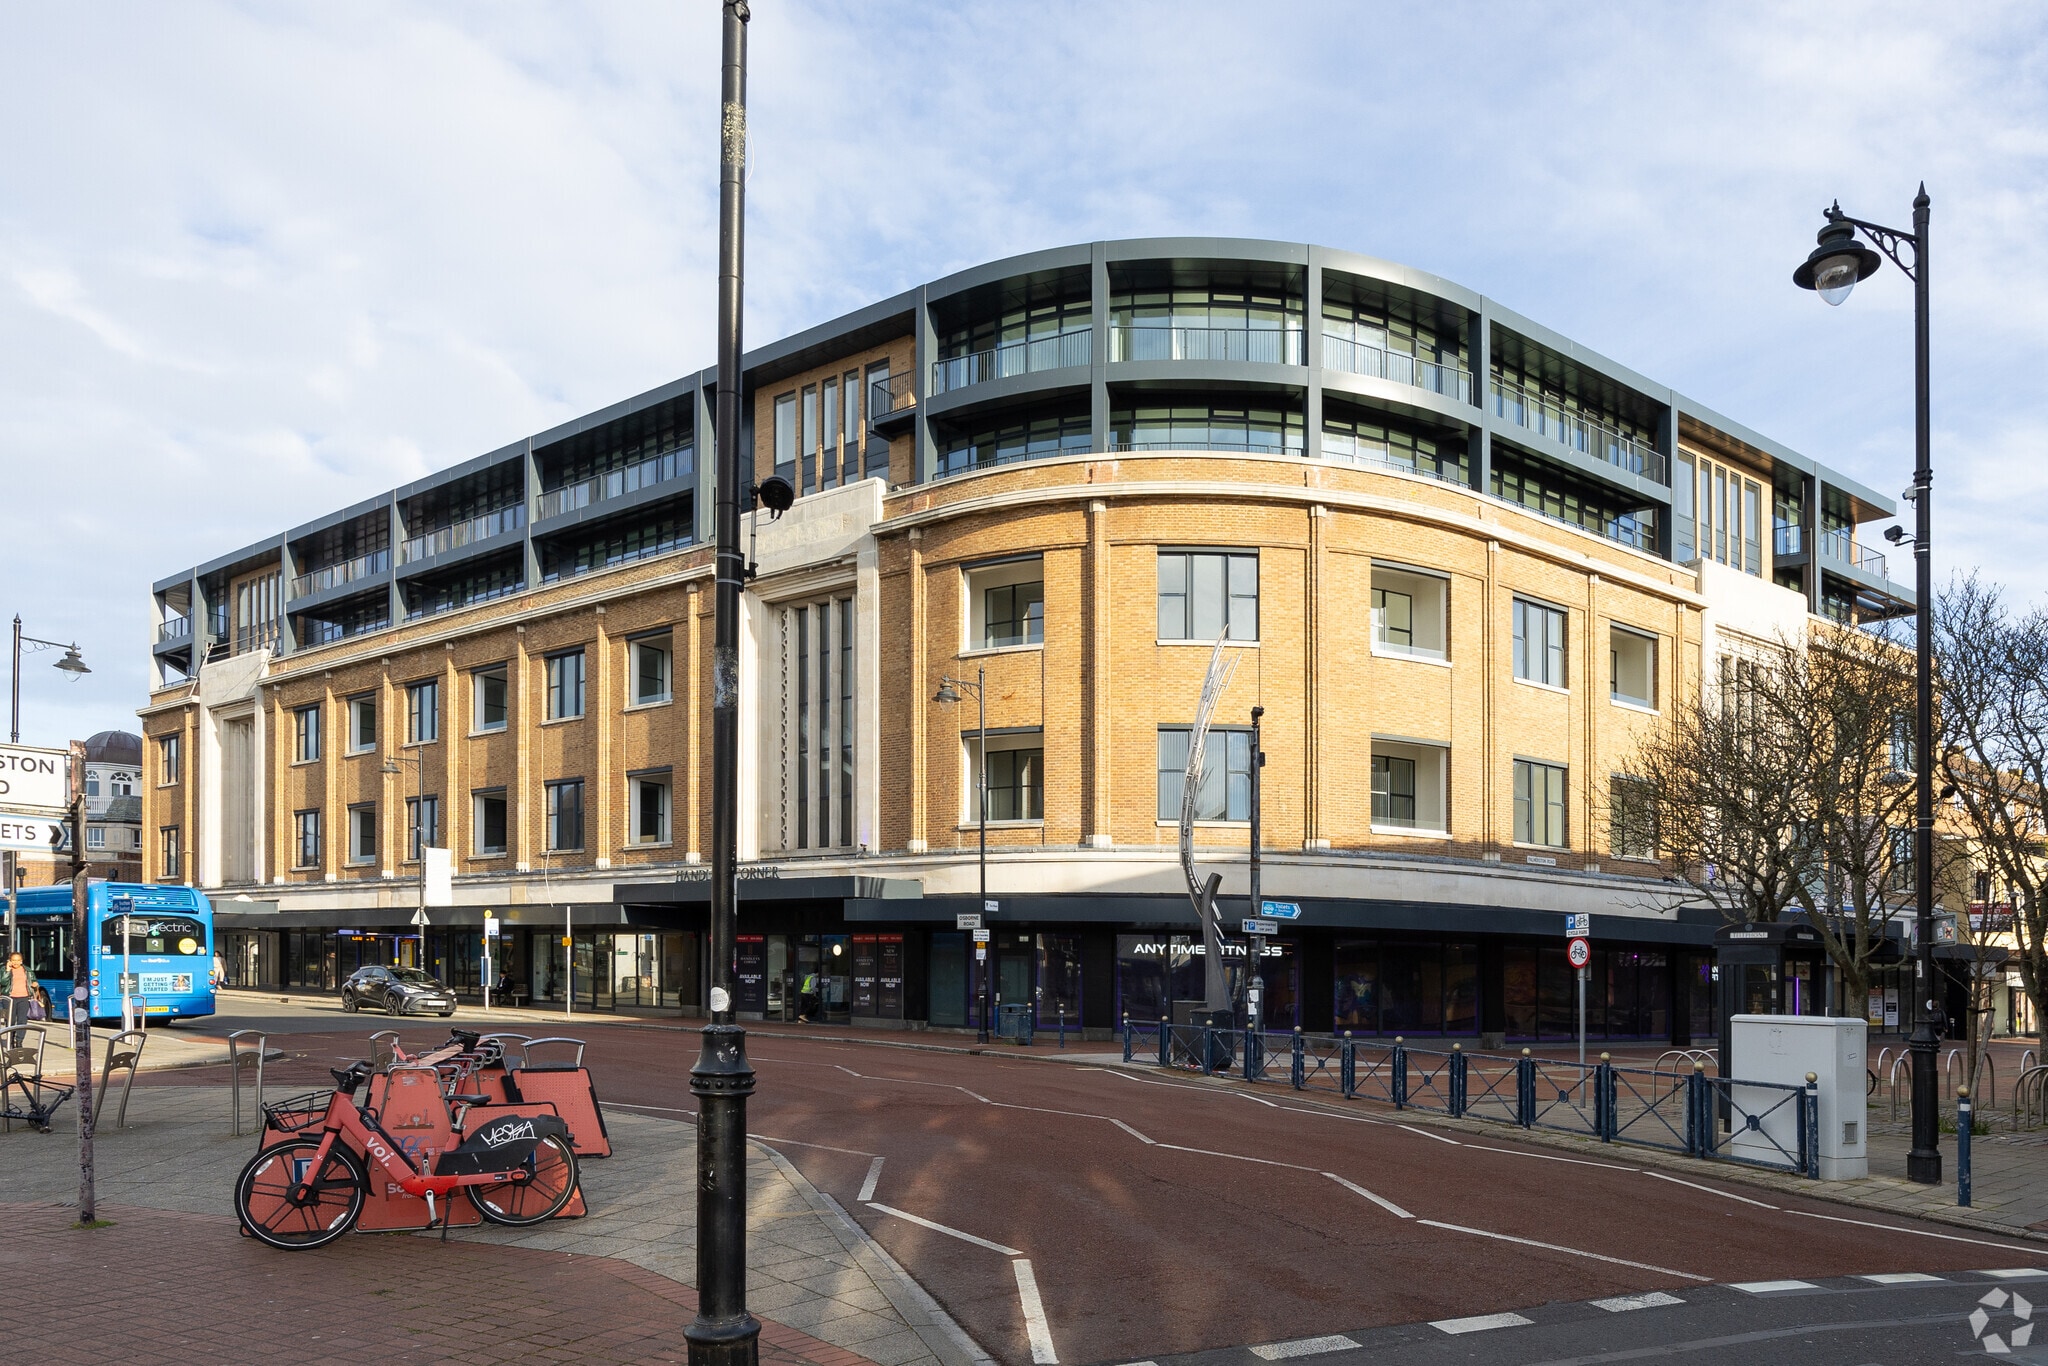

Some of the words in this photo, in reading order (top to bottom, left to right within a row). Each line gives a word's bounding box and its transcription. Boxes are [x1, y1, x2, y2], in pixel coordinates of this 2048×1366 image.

[1, 823, 36, 840] ETS
[676, 865, 712, 881] HANDL
[737, 866, 779, 880] ORNER
[1568, 916, 1574, 928] P
[1134, 943, 1206, 955] ANYTIME
[1220, 945, 1282, 957] ITNSS
